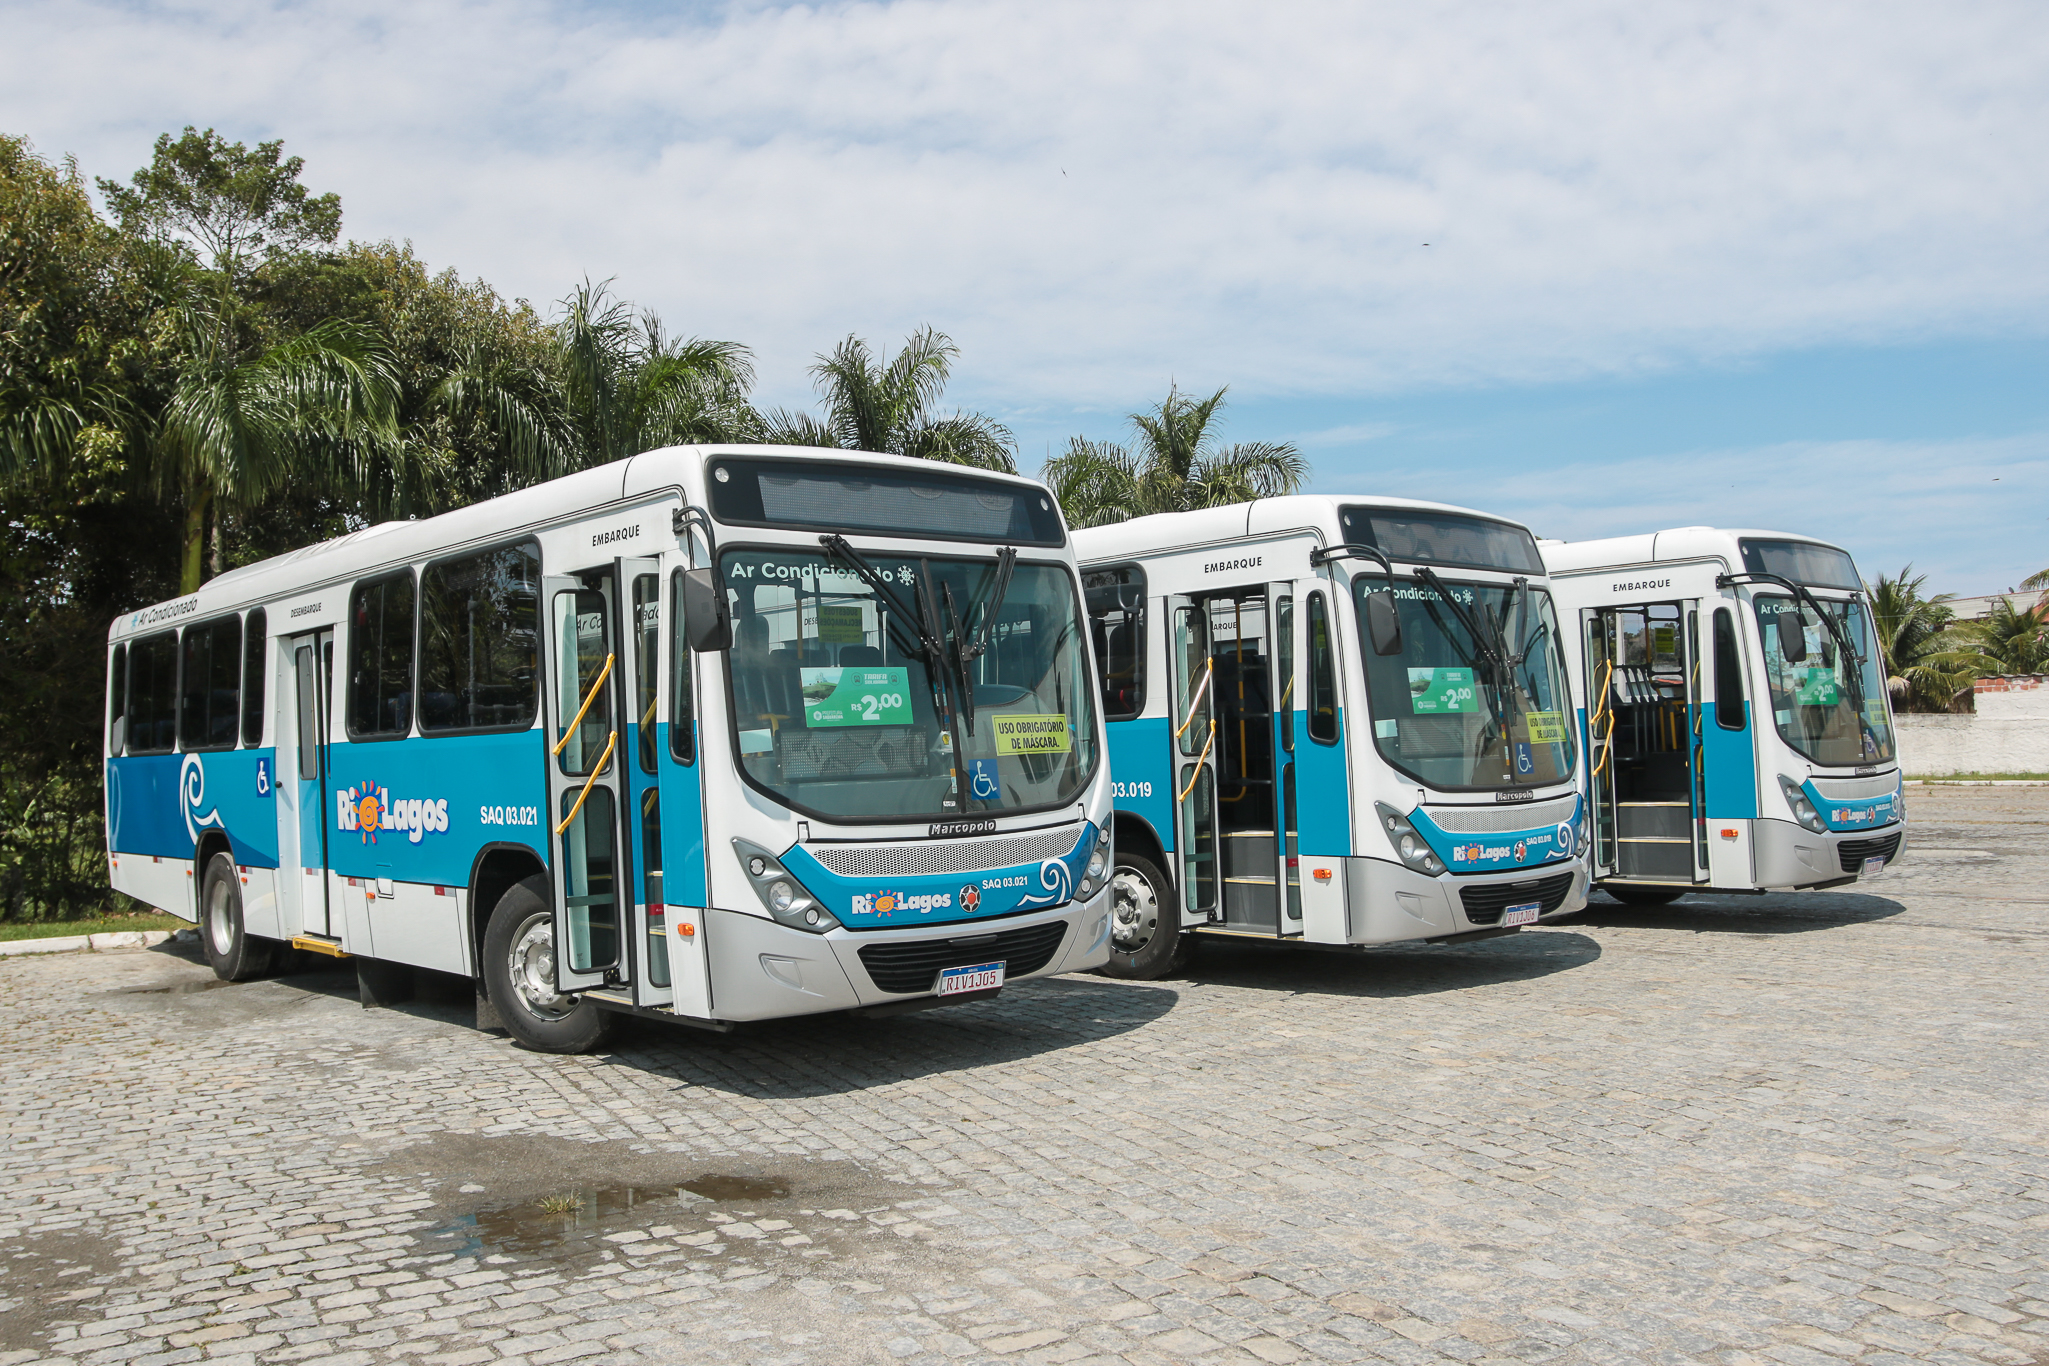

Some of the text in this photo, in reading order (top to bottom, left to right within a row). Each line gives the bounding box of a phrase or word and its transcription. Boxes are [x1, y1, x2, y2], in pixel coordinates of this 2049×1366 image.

[592, 525, 640, 547] EMBARQUE
[730, 562, 754, 578] Ar
[1204, 556, 1262, 574] EMBARQUE
[1613, 578, 1671, 592] EMBARQUE
[138, 596, 198, 626] Ar Condicionado
[290, 602, 322, 618] DESEMBARQUE
[1761, 604, 1771, 614] Ar
[851, 693, 902, 720] R$ 2,00
[1446, 687, 1472, 709] 2,00
[998, 718, 1064, 734] USO OBRIGATÓRIO
[1011, 734, 1060, 749] DE MÁSCARA.
[1111, 781, 1152, 798] 03.019
[1497, 790, 1533, 801] Marcopolo
[381, 787, 449, 843] Lagos
[480, 805, 538, 826] SAQ 03.021
[931, 820, 995, 835] Marcopolo
[1480, 844, 1510, 862] Lagos
[982, 876, 1028, 890] SAQ 03.021
[897, 892, 951, 914] Lagos
[946, 971, 996, 991] RIV1J05
